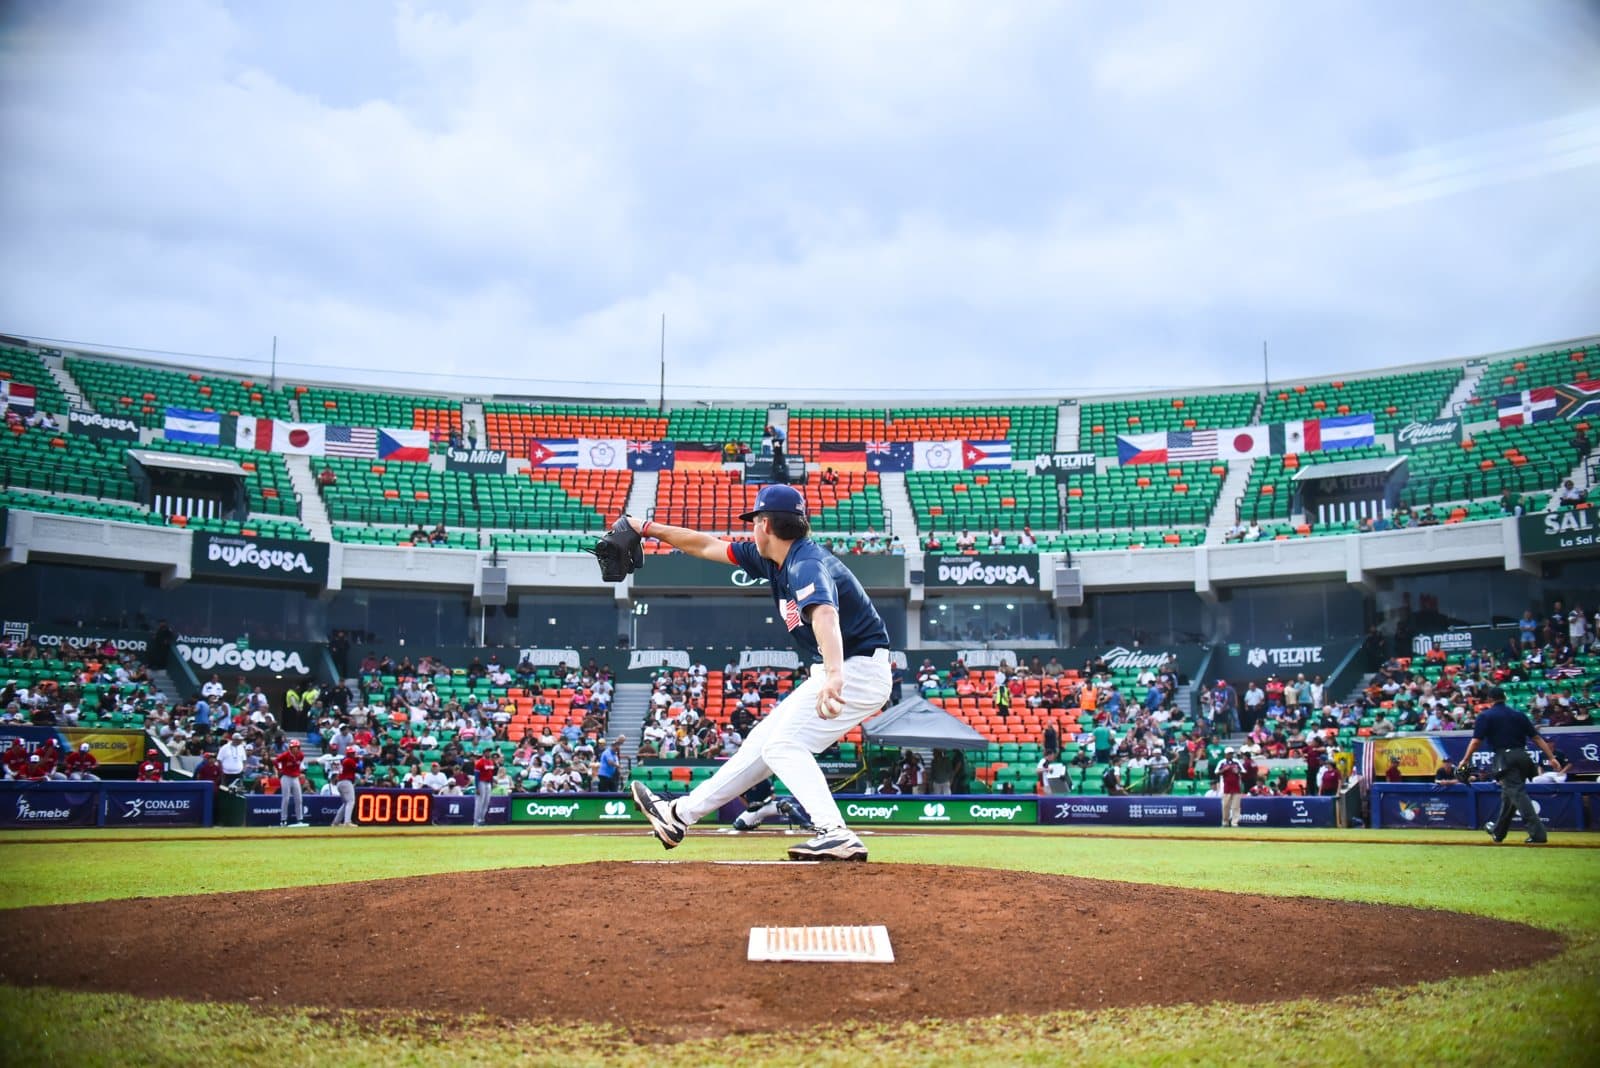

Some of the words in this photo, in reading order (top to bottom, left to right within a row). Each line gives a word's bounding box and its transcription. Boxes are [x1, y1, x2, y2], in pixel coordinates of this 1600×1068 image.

[1398, 421, 1457, 442] Caliente
[469, 450, 505, 464] Mifel
[1053, 453, 1096, 467] TECATE
[1544, 510, 1593, 535] SAL
[1561, 538, 1573, 547] La
[1575, 535, 1593, 545] Sal
[208, 543, 313, 573] DUNOSUSA
[938, 561, 1035, 585] DUNOSUSA
[176, 634, 224, 645] Abarrotes
[1101, 646, 1177, 668] Calient
[1268, 646, 1322, 664] TECATE
[144, 800, 190, 809] CONADE
[526, 802, 574, 818] Corpay
[847, 804, 894, 819] Corpay
[969, 805, 1017, 819] Corpay
[1071, 804, 1108, 813] CONADE
